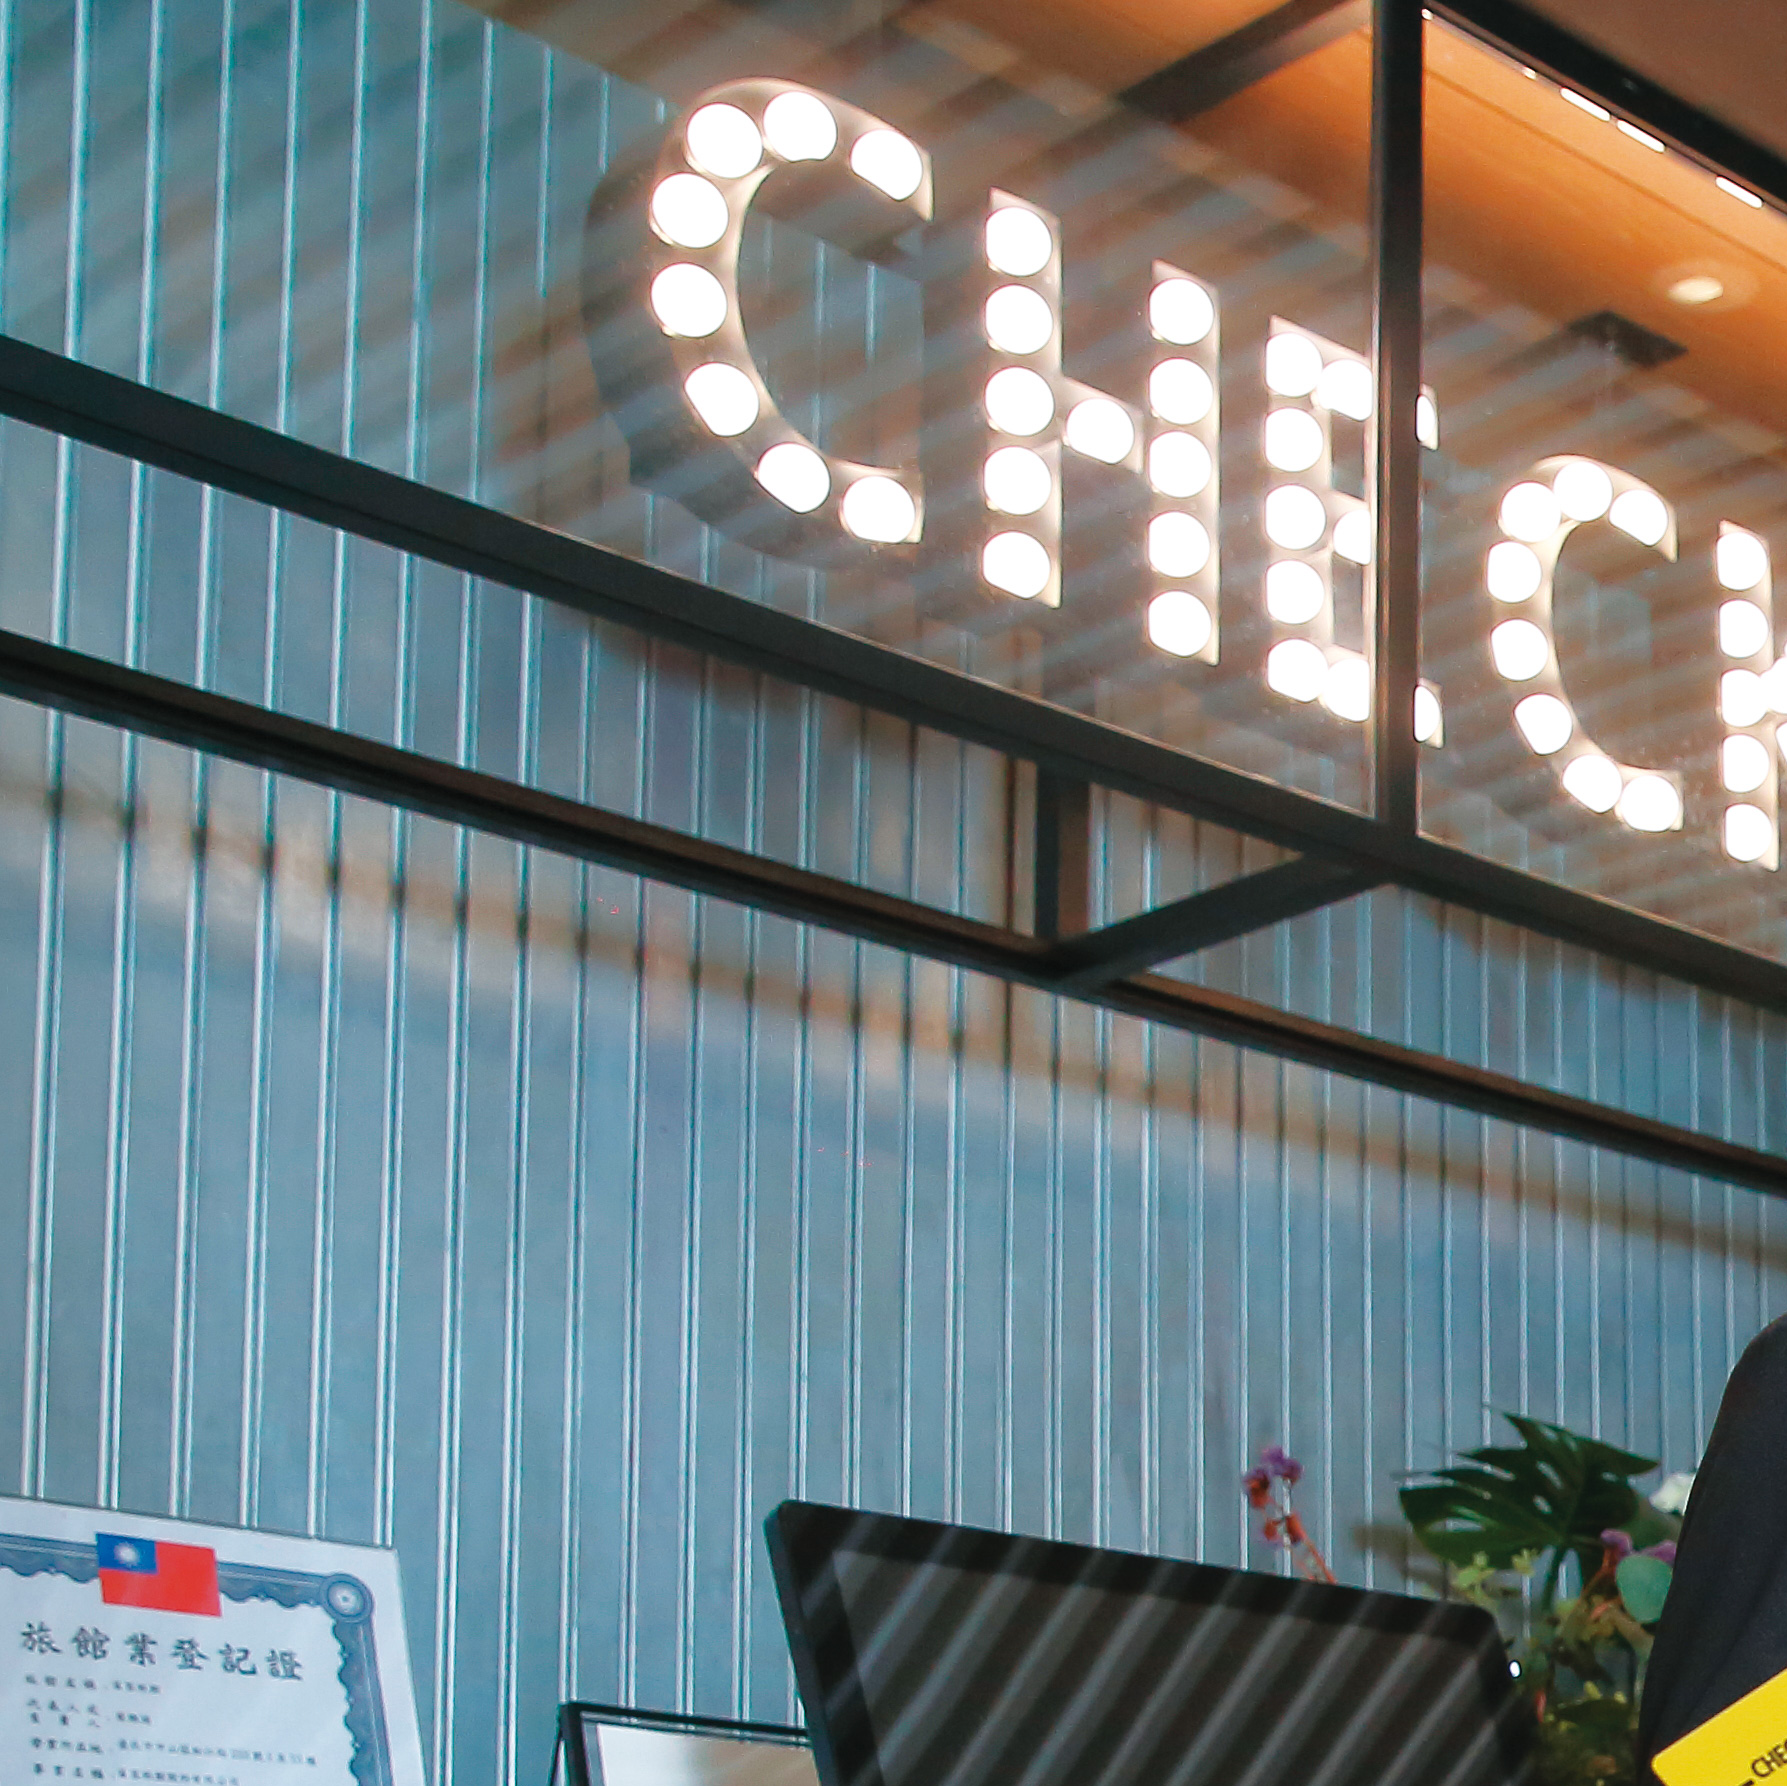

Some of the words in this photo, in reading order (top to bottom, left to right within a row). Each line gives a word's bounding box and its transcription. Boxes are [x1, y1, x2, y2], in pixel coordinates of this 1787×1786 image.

[20, 1620, 304, 1681] 旅館業登記證
